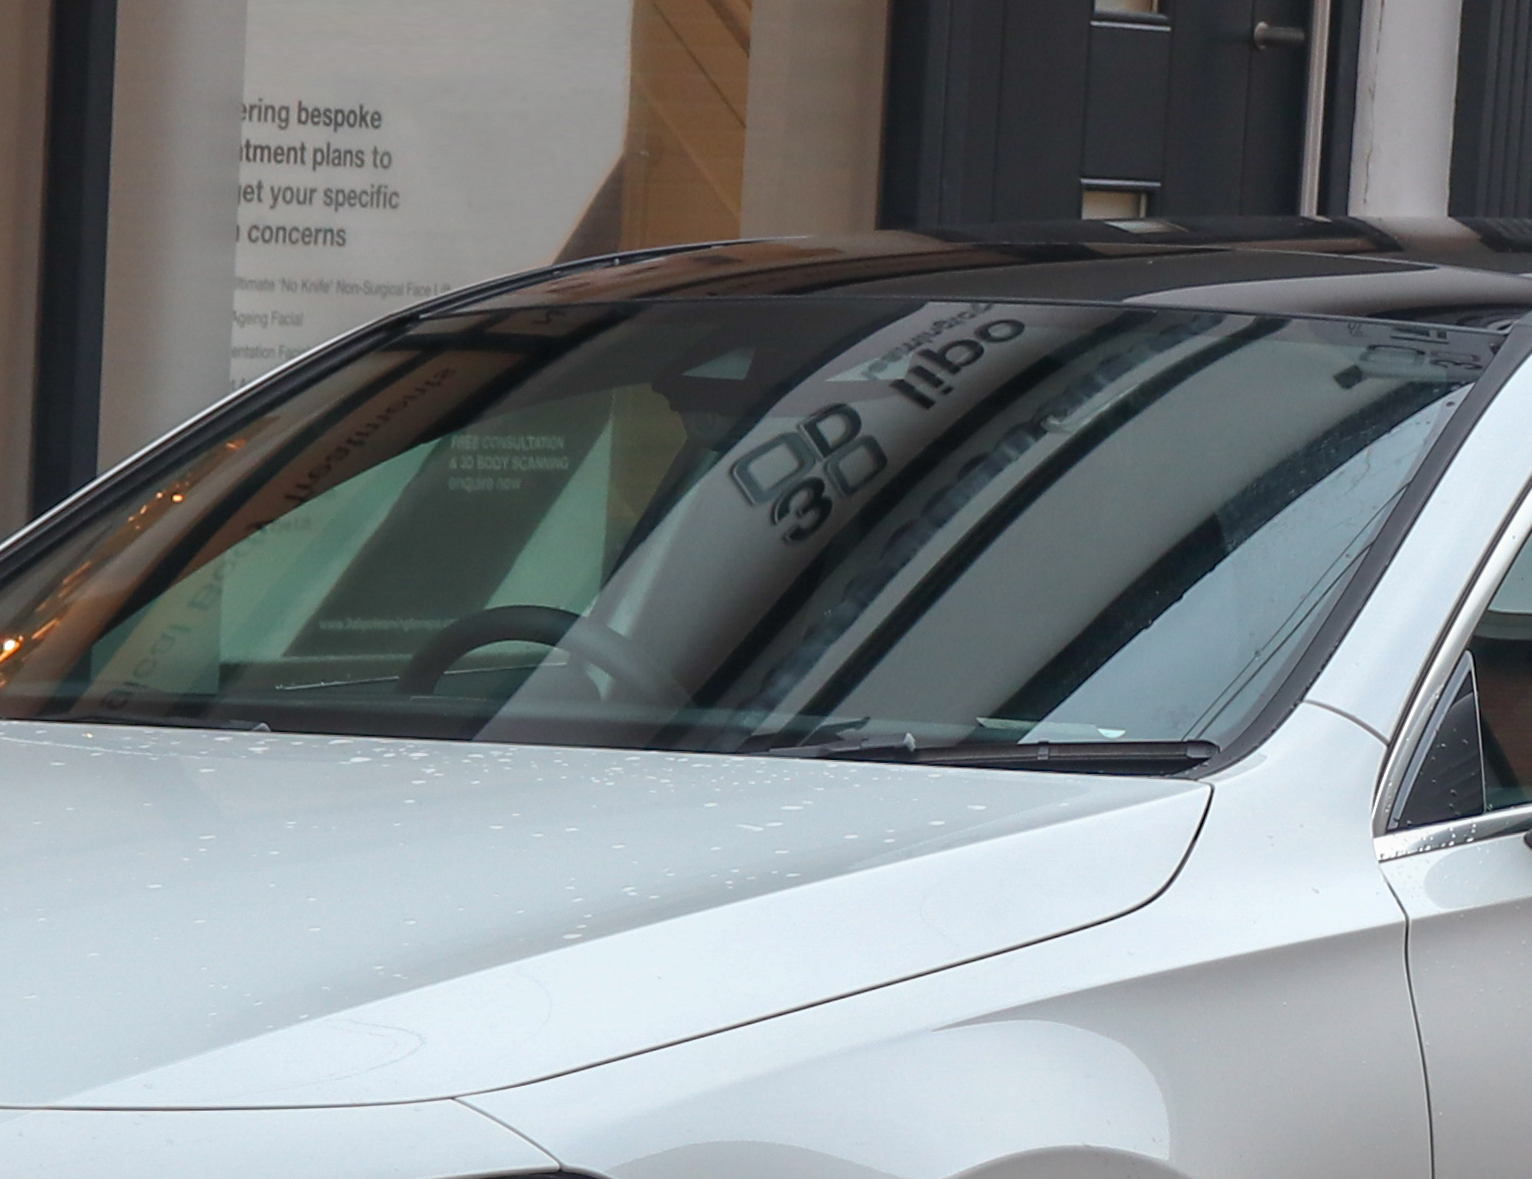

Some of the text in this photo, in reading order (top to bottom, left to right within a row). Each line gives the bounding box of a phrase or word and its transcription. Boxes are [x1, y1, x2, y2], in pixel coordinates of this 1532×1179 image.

[297, 100, 382, 133] bespoke
[239, 138, 392, 172] tment plans to
[269, 183, 317, 210] your
[323, 183, 400, 213] specific
[247, 224, 347, 247] concerns
